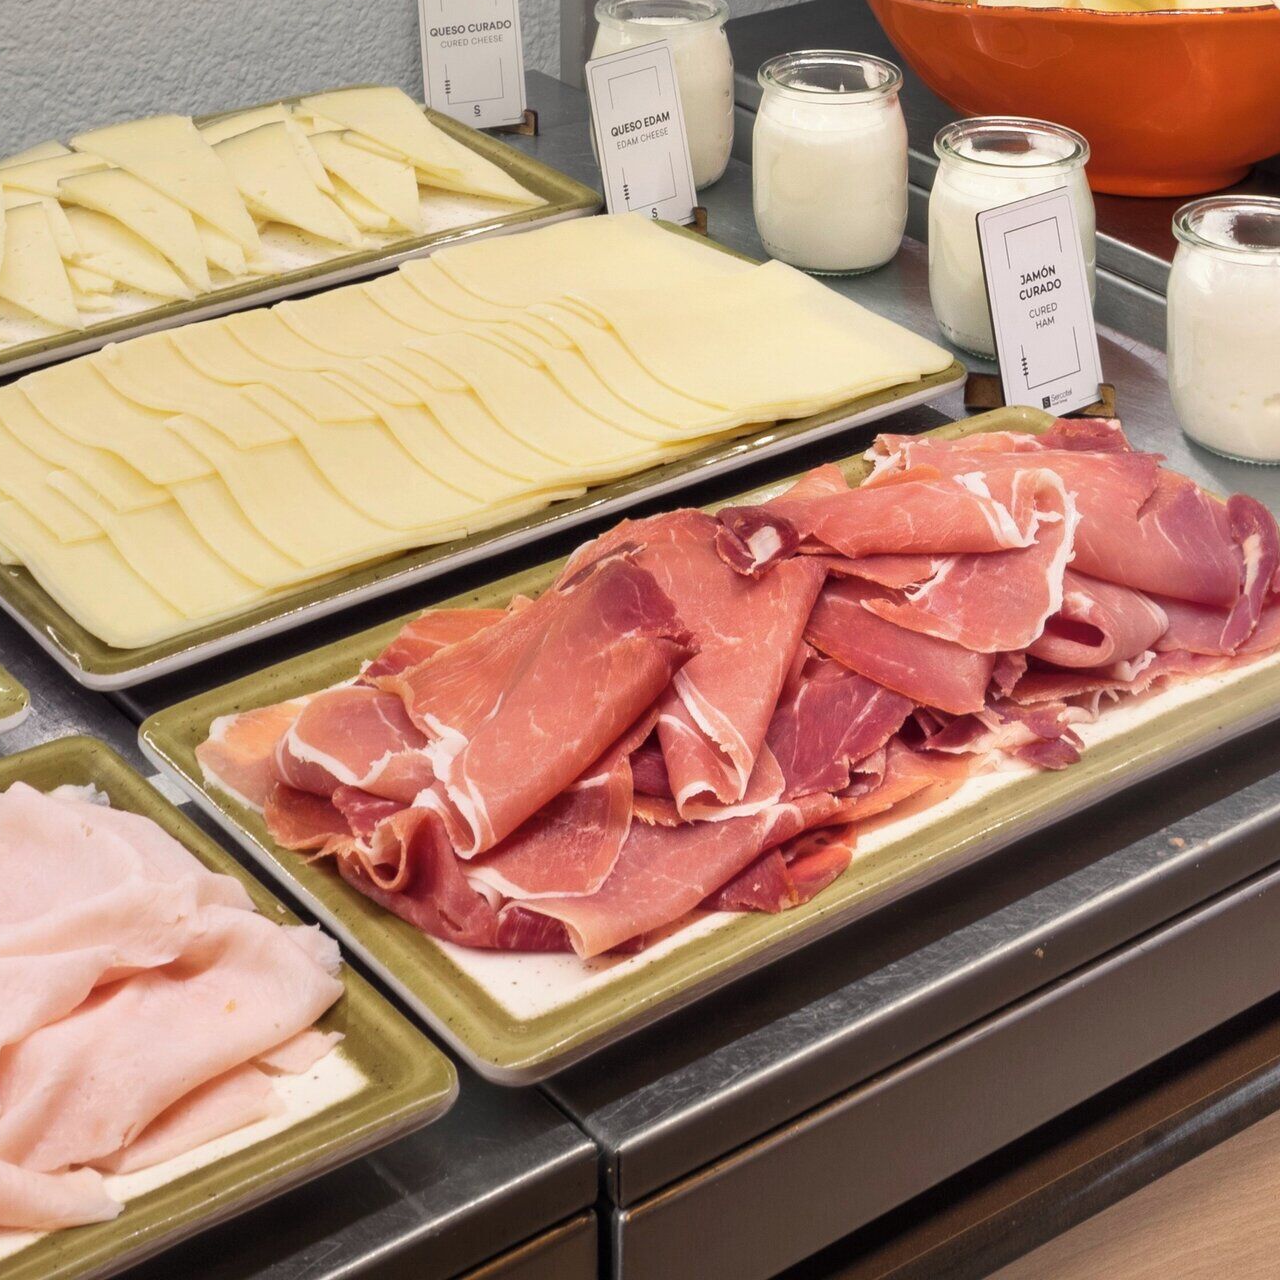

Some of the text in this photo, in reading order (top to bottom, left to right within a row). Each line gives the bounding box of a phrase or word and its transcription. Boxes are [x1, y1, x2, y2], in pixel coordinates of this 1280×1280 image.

[429, 19, 512, 38] QUESO CURADO
[440, 33, 504, 49] CURED CHEESE
[610, 111, 671, 137] QUESO EDAM
[616, 126, 670, 150] EDAM CHEESE
[1020, 264, 1057, 286] JAMÓN
[1019, 278, 1062, 301] CURADO
[1028, 301, 1058, 319] CURED
[1035, 316, 1055, 330] HAM
